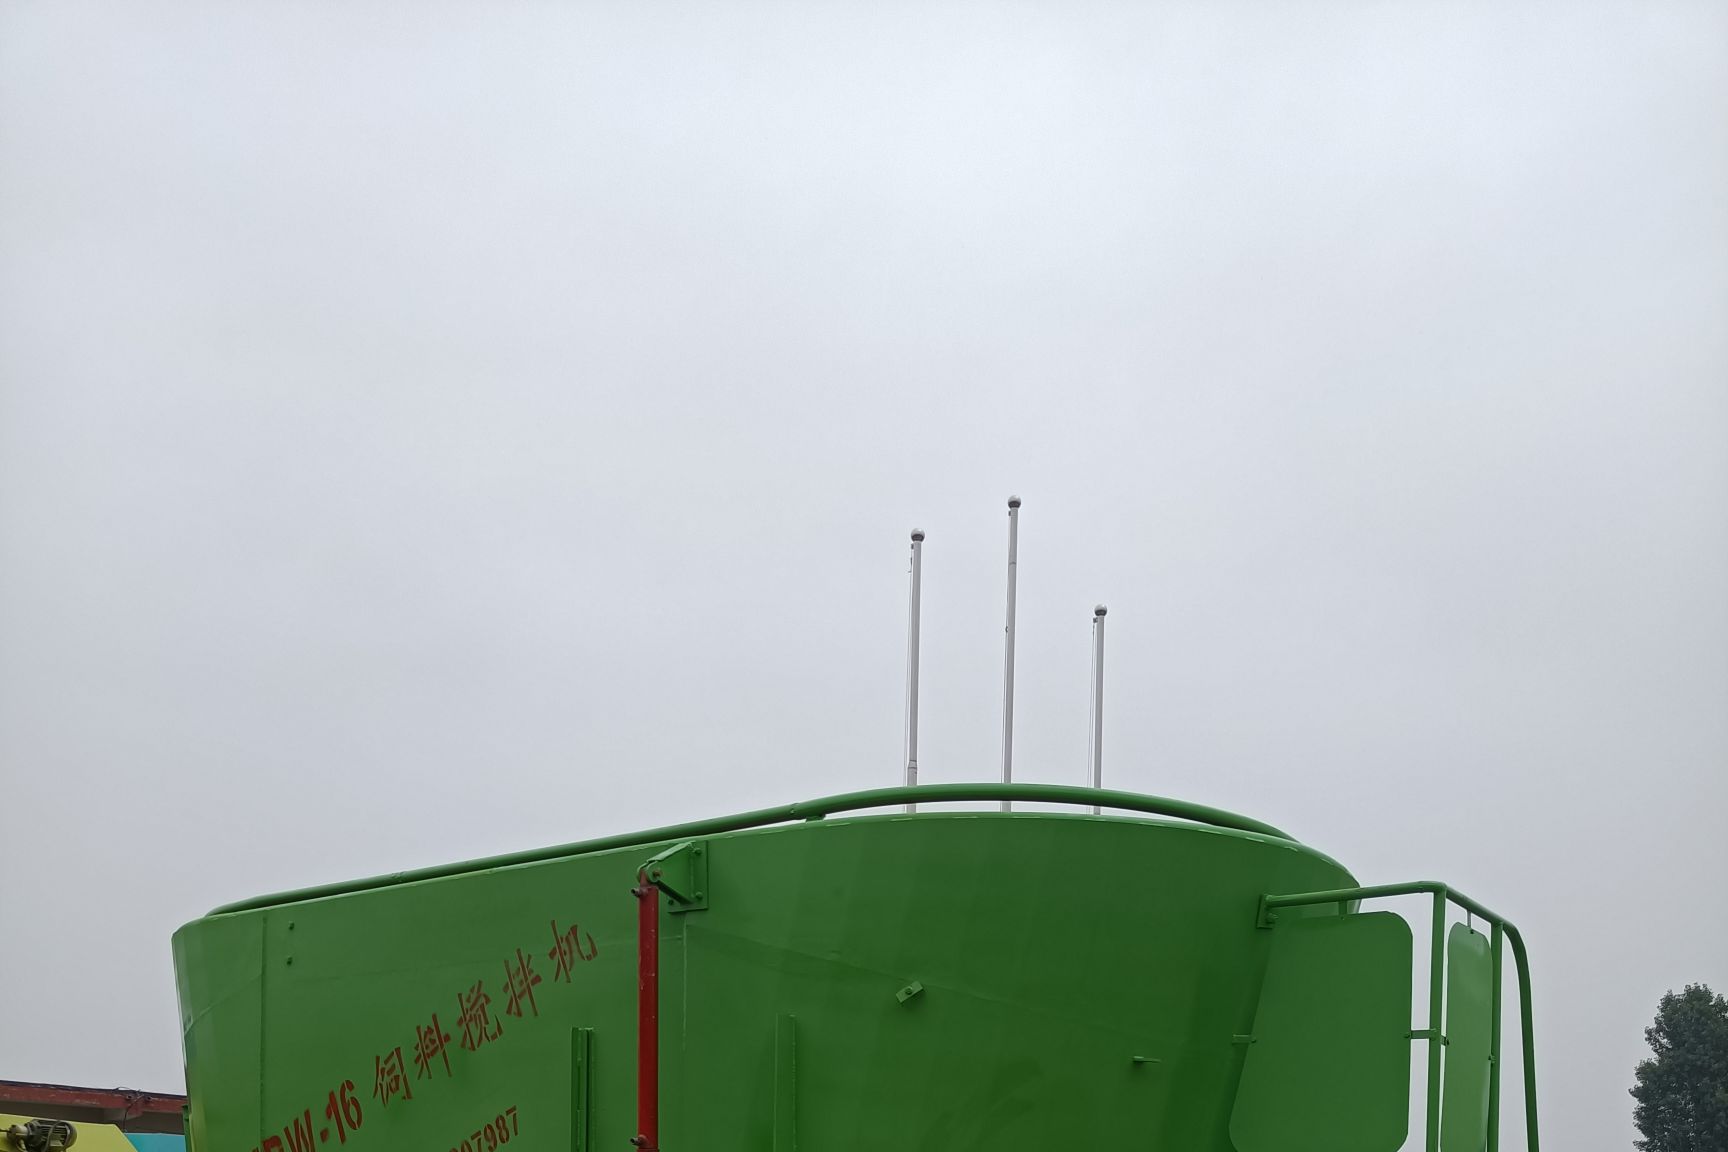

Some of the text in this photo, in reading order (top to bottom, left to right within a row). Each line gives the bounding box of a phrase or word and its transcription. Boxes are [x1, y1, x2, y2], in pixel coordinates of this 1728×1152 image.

[373, 919, 599, 1107] 饲料搅拌机
